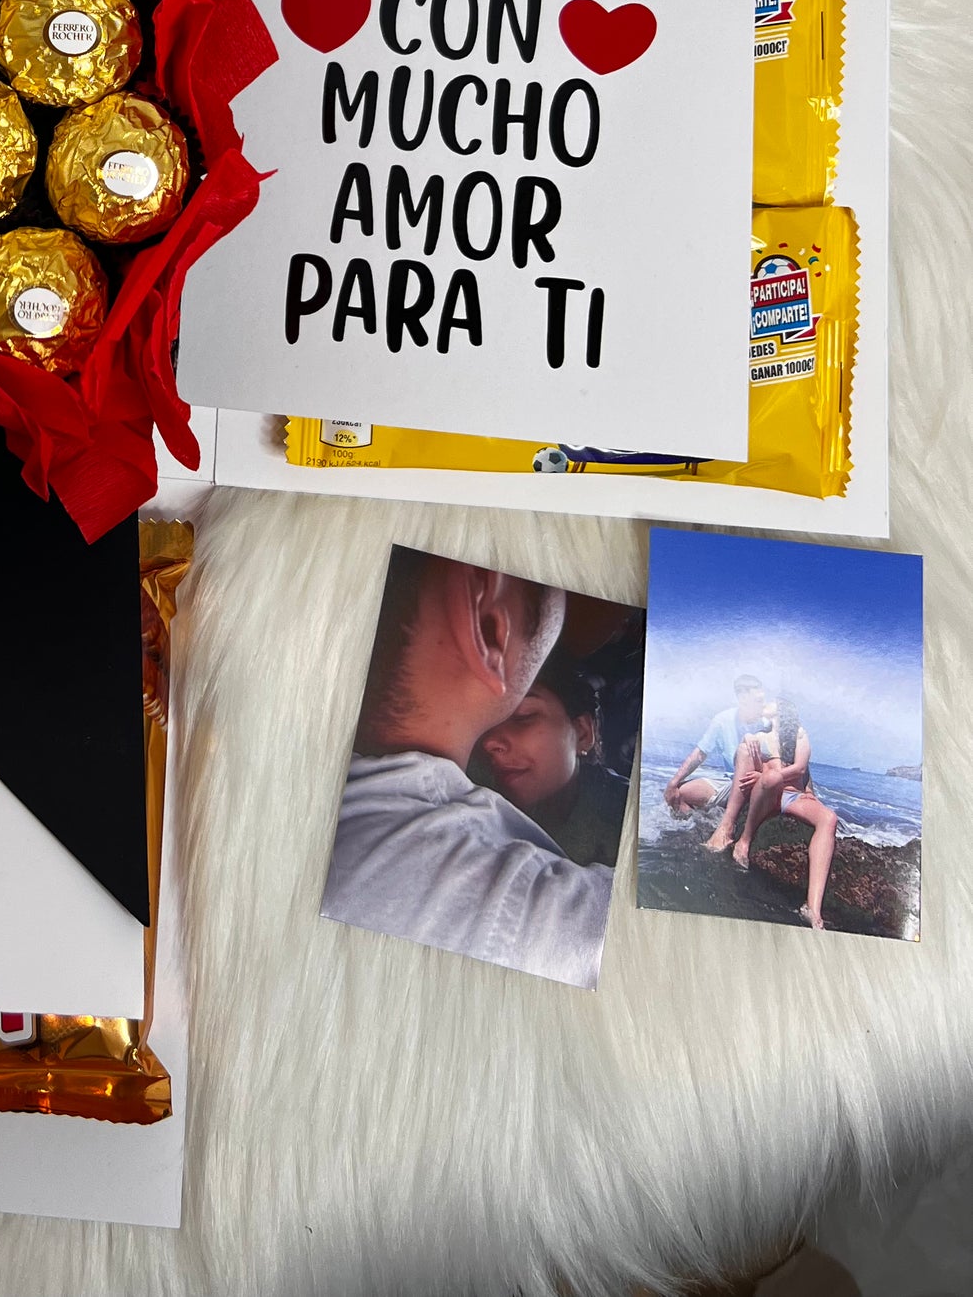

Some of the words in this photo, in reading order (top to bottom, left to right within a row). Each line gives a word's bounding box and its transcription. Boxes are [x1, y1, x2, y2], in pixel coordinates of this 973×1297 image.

[52, 23, 94, 32] FERRERO
[52, 31, 93, 41] ROCHER
[321, 61, 600, 168] MUCHO
[329, 162, 562, 269] AMOR
[285, 253, 483, 354] PARA
[534, 277, 605, 369] TI
[753, 304, 808, 333] ¡COMPARTE!
[750, 363, 783, 381] GANAR
